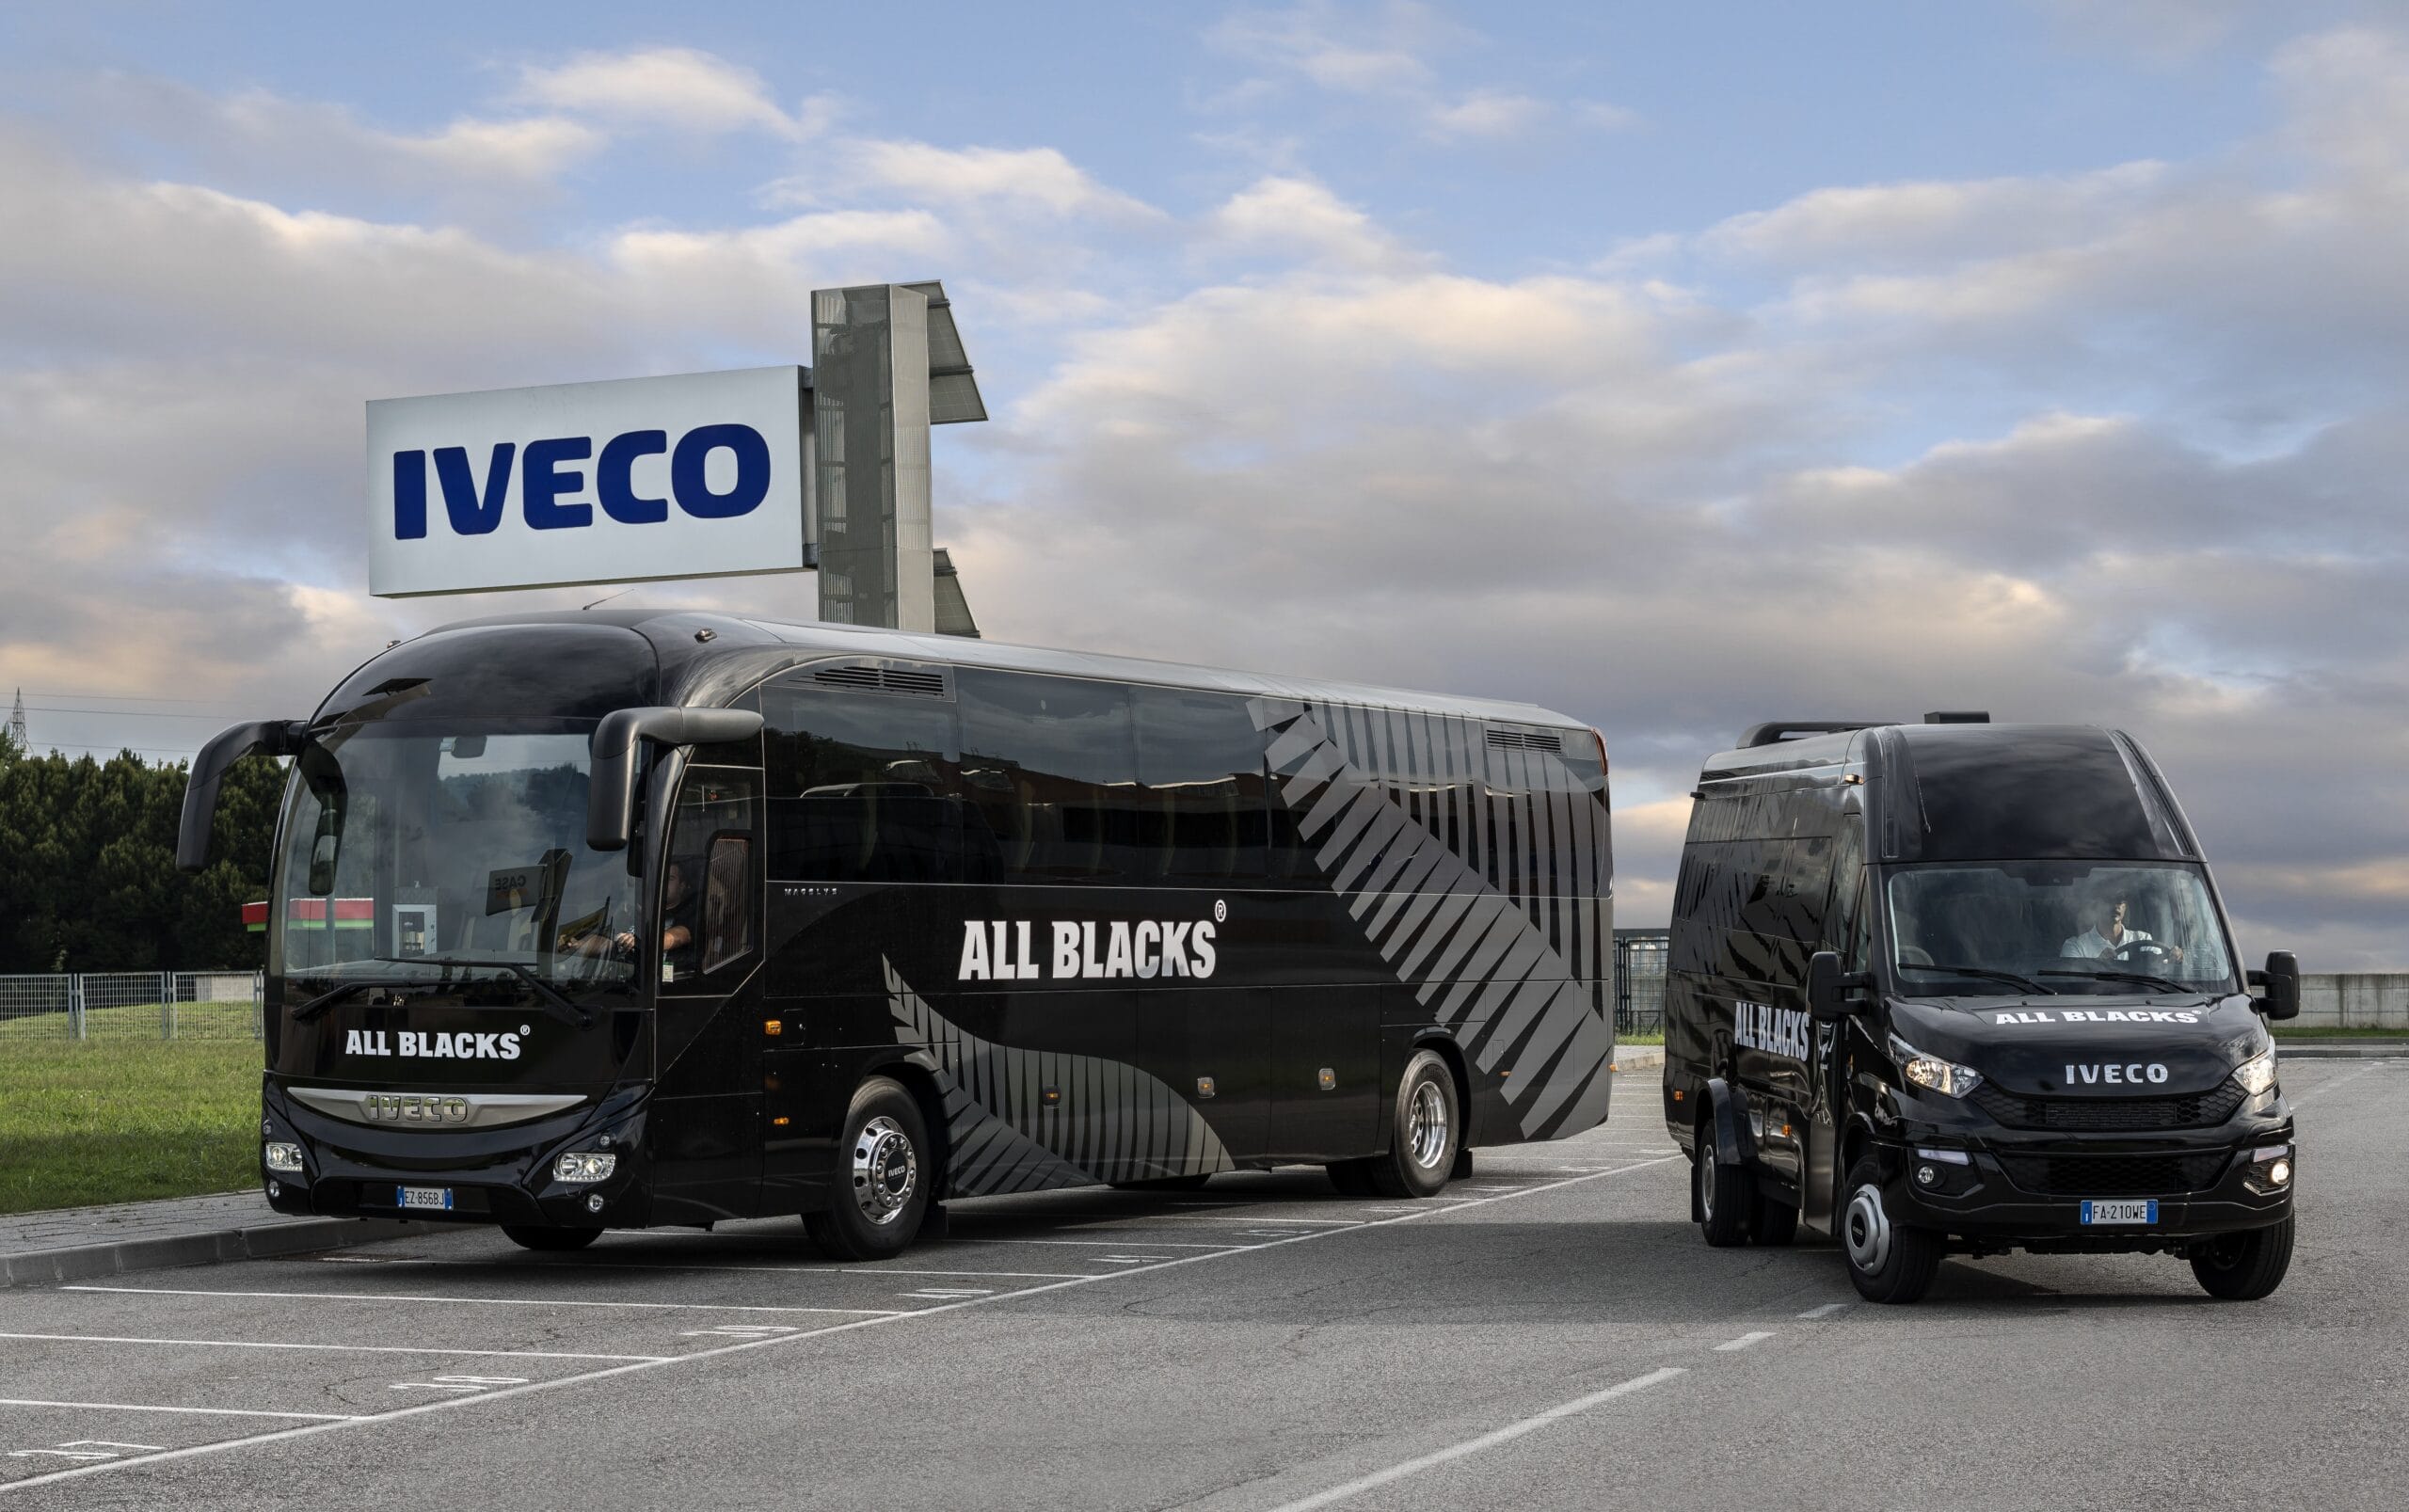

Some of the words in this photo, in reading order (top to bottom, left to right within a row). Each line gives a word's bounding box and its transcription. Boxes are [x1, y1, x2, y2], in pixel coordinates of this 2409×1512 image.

[393, 423, 771, 540] IVECO
[958, 920, 1039, 979] ALL
[1734, 1001, 1756, 1048] ALL
[1758, 1005, 1811, 1062] BLACKS
[1996, 1011, 2056, 1025] ALL
[345, 1029, 391, 1056] ALL
[2066, 1063, 2168, 1084] IVECO
[369, 1094, 469, 1122] IVECO
[888, 1165, 905, 1178] IVECO
[388, 1375, 529, 1392] 38
